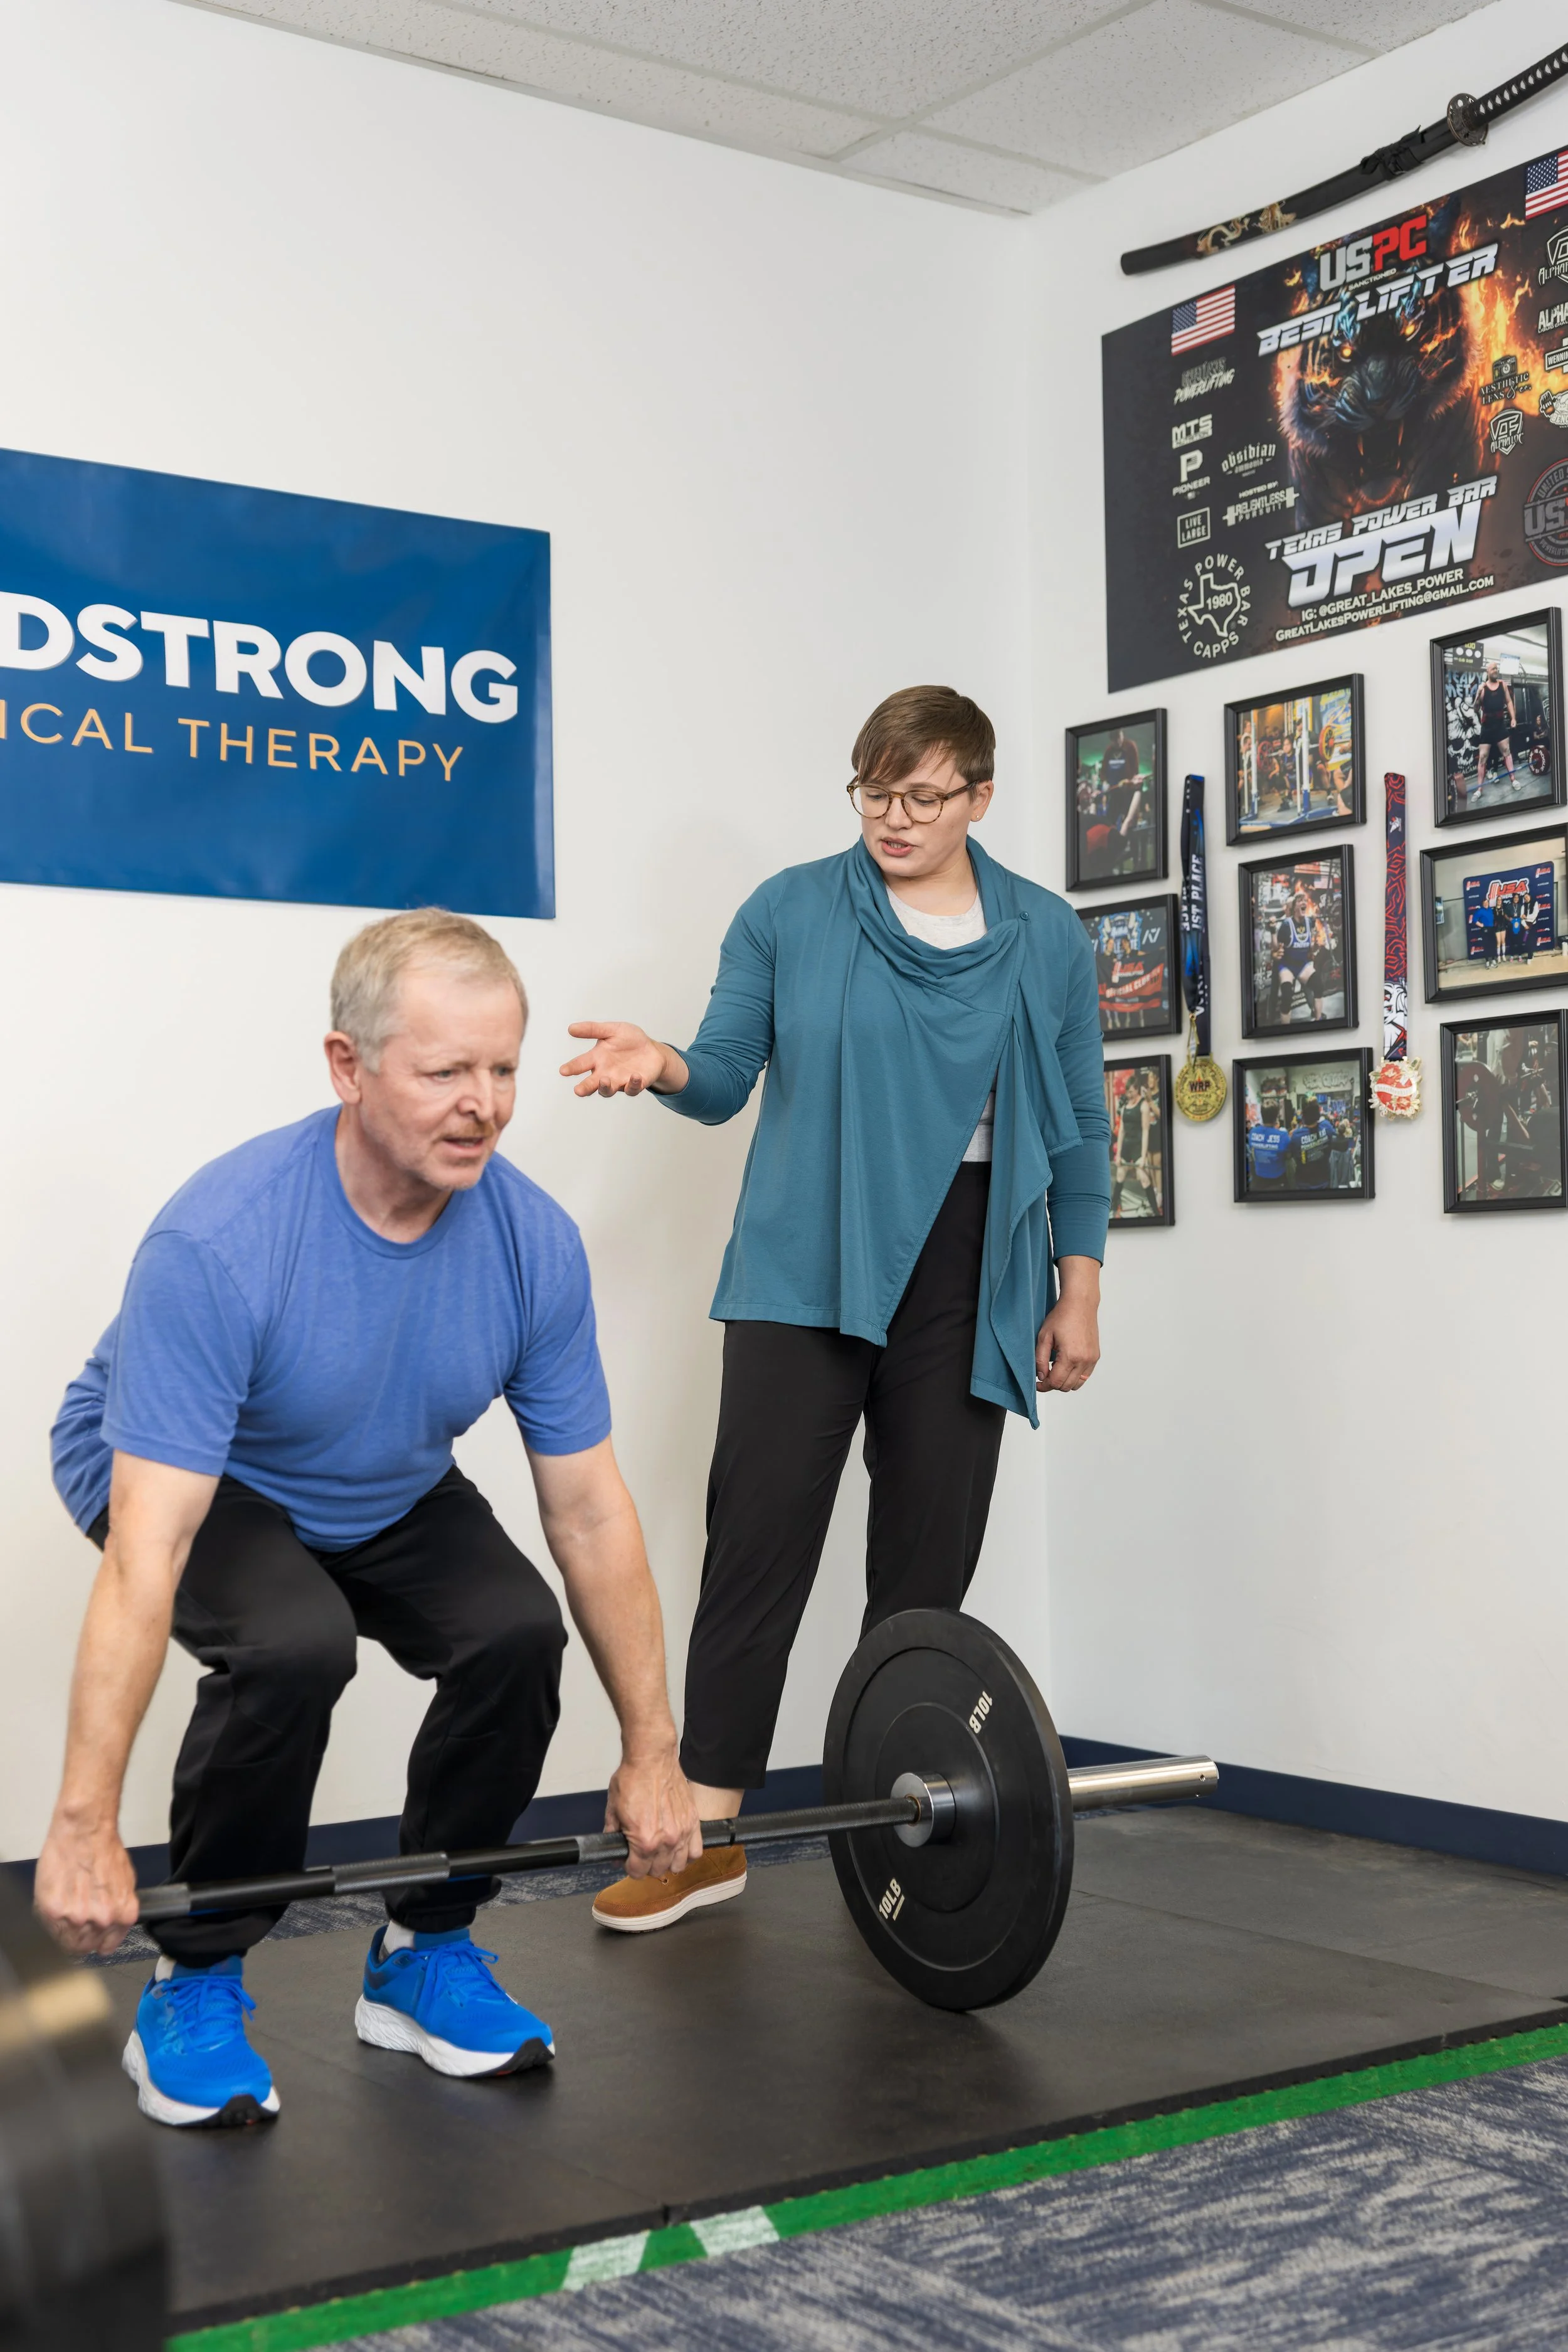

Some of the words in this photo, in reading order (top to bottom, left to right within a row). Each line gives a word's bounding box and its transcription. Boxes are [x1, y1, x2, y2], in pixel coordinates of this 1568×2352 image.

[1320, 215, 1426, 291] USPC
[1348, 268, 1396, 290] SANCTIONED
[1257, 302, 1341, 356] BEST
[1355, 243, 1498, 320] LIFTER
[1172, 413, 1212, 440] MTS
[1172, 476, 1210, 496] PIONEER
[1239, 484, 1267, 499] HOSTED
[1537, 468, 1564, 499] UNITED
[1236, 490, 1286, 516] RELENTLESS
[1238, 502, 1282, 522] PURSUIT
[1264, 521, 1343, 560] TEXAS
[1351, 494, 1438, 536] POWER
[1447, 475, 1497, 508] BAR
[1524, 497, 1568, 536] US
[1182, 525, 1207, 543] LARGE
[1185, 514, 1202, 529] LIVE
[1281, 499, 1482, 608] OPEN
[1177, 578, 1193, 644] TEXAS
[1195, 553, 1244, 581] POWER
[1237, 585, 1251, 627] BAR
[1206, 591, 1233, 610] 1980
[1301, 609, 1318, 622] IG:
[1319, 568, 1464, 618] @GREAT_LAKES_POWER
[0, 591, 518, 724] DSTRONG
[1194, 631, 1239, 659] CAPPS
[0, 699, 153, 754] ICAL
[178, 718, 464, 781] THERAPY
[1498, 881, 1527, 896] USA
[969, 1690, 992, 1734] 10LB
[879, 1878, 901, 1920] 10LB
